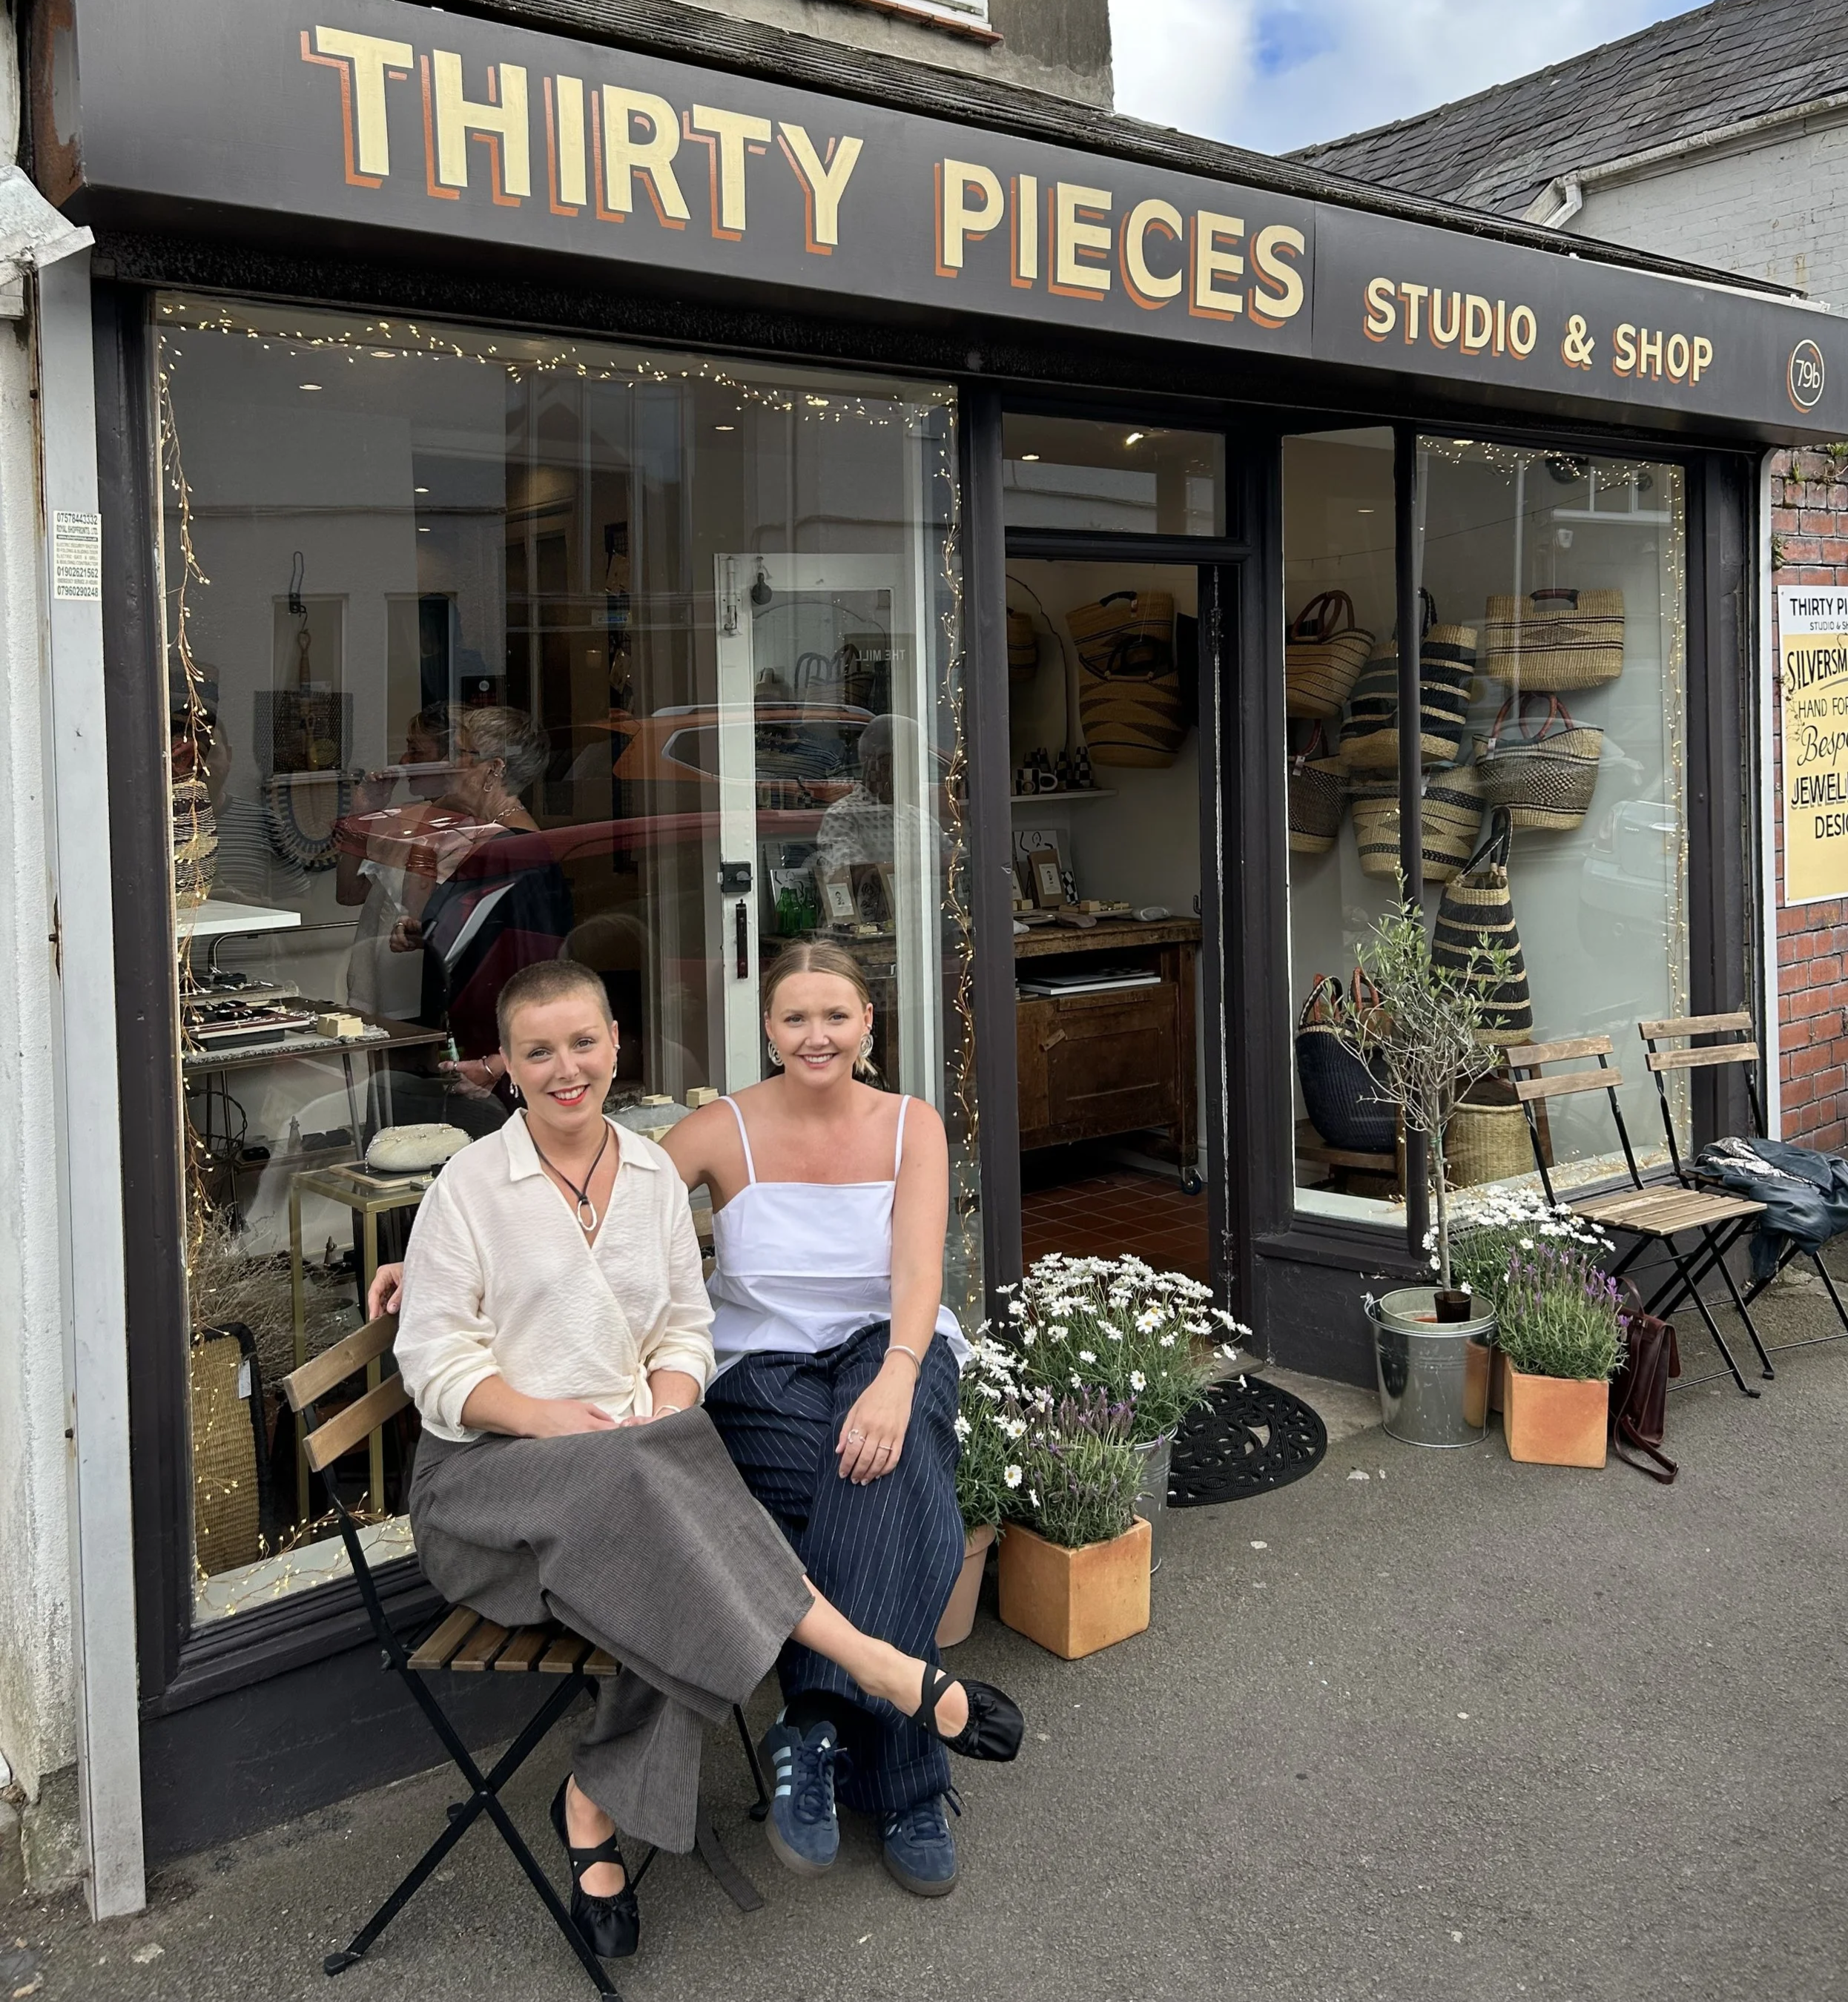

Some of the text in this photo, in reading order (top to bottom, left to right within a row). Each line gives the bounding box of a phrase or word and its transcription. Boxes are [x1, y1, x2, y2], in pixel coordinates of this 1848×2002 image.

[300, 24, 1306, 330] THIRTY PIECES
[1363, 277, 1714, 387] STUDIO & SHOP
[1795, 359, 1821, 389] 79b
[56, 512, 97, 525] 07578443332
[56, 566, 98, 578] 01902621562
[56, 586, 98, 598] 07960290248
[1789, 598, 1833, 616] THIRTY
[1809, 621, 1835, 630] STUDIO
[1836, 621, 1841, 630] &
[1798, 698, 1827, 718] HAND
[1797, 725, 1848, 767] Besp
[1791, 772, 1848, 810] JEWEL
